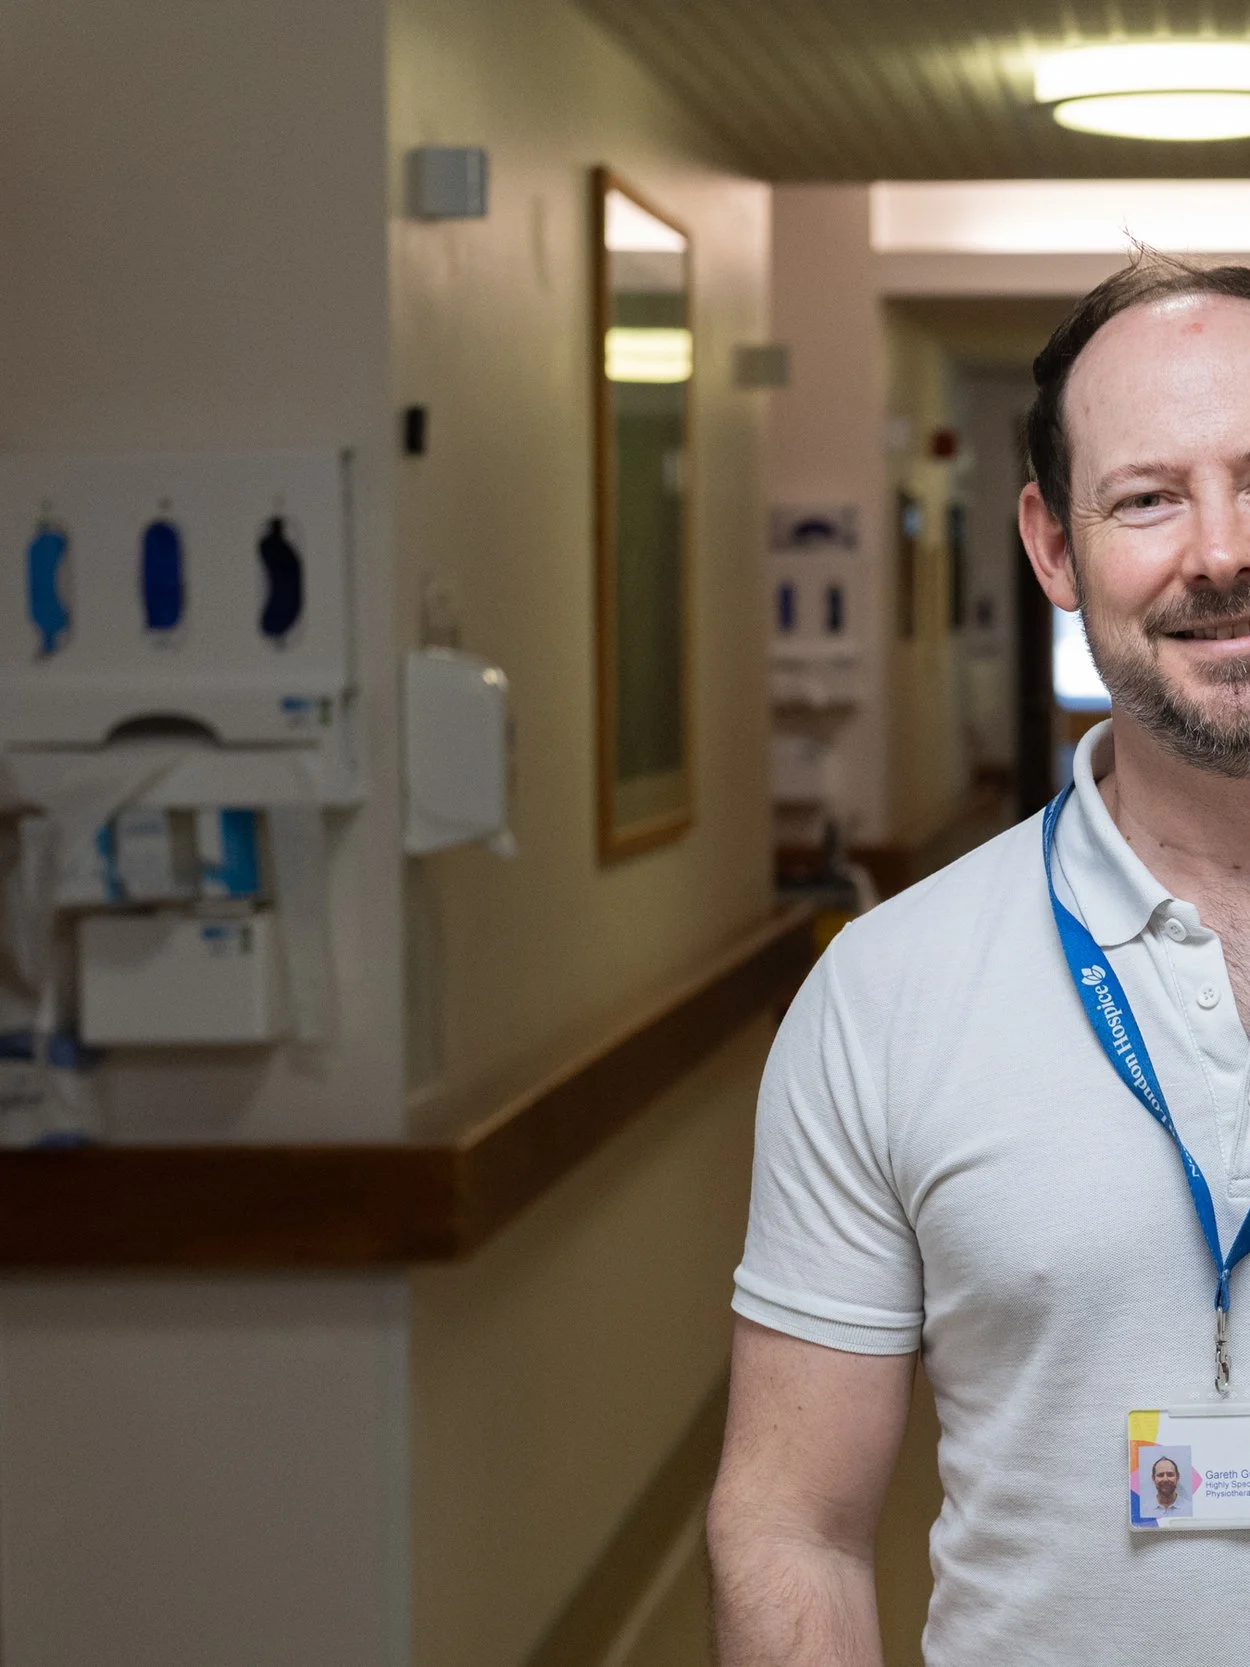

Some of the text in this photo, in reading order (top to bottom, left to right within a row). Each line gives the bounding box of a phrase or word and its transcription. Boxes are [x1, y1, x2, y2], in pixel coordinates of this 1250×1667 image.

[1095, 985, 1132, 1054] Hospice
[1205, 1470, 1238, 1479] Gareth
[1205, 1481, 1229, 1489] Highly
